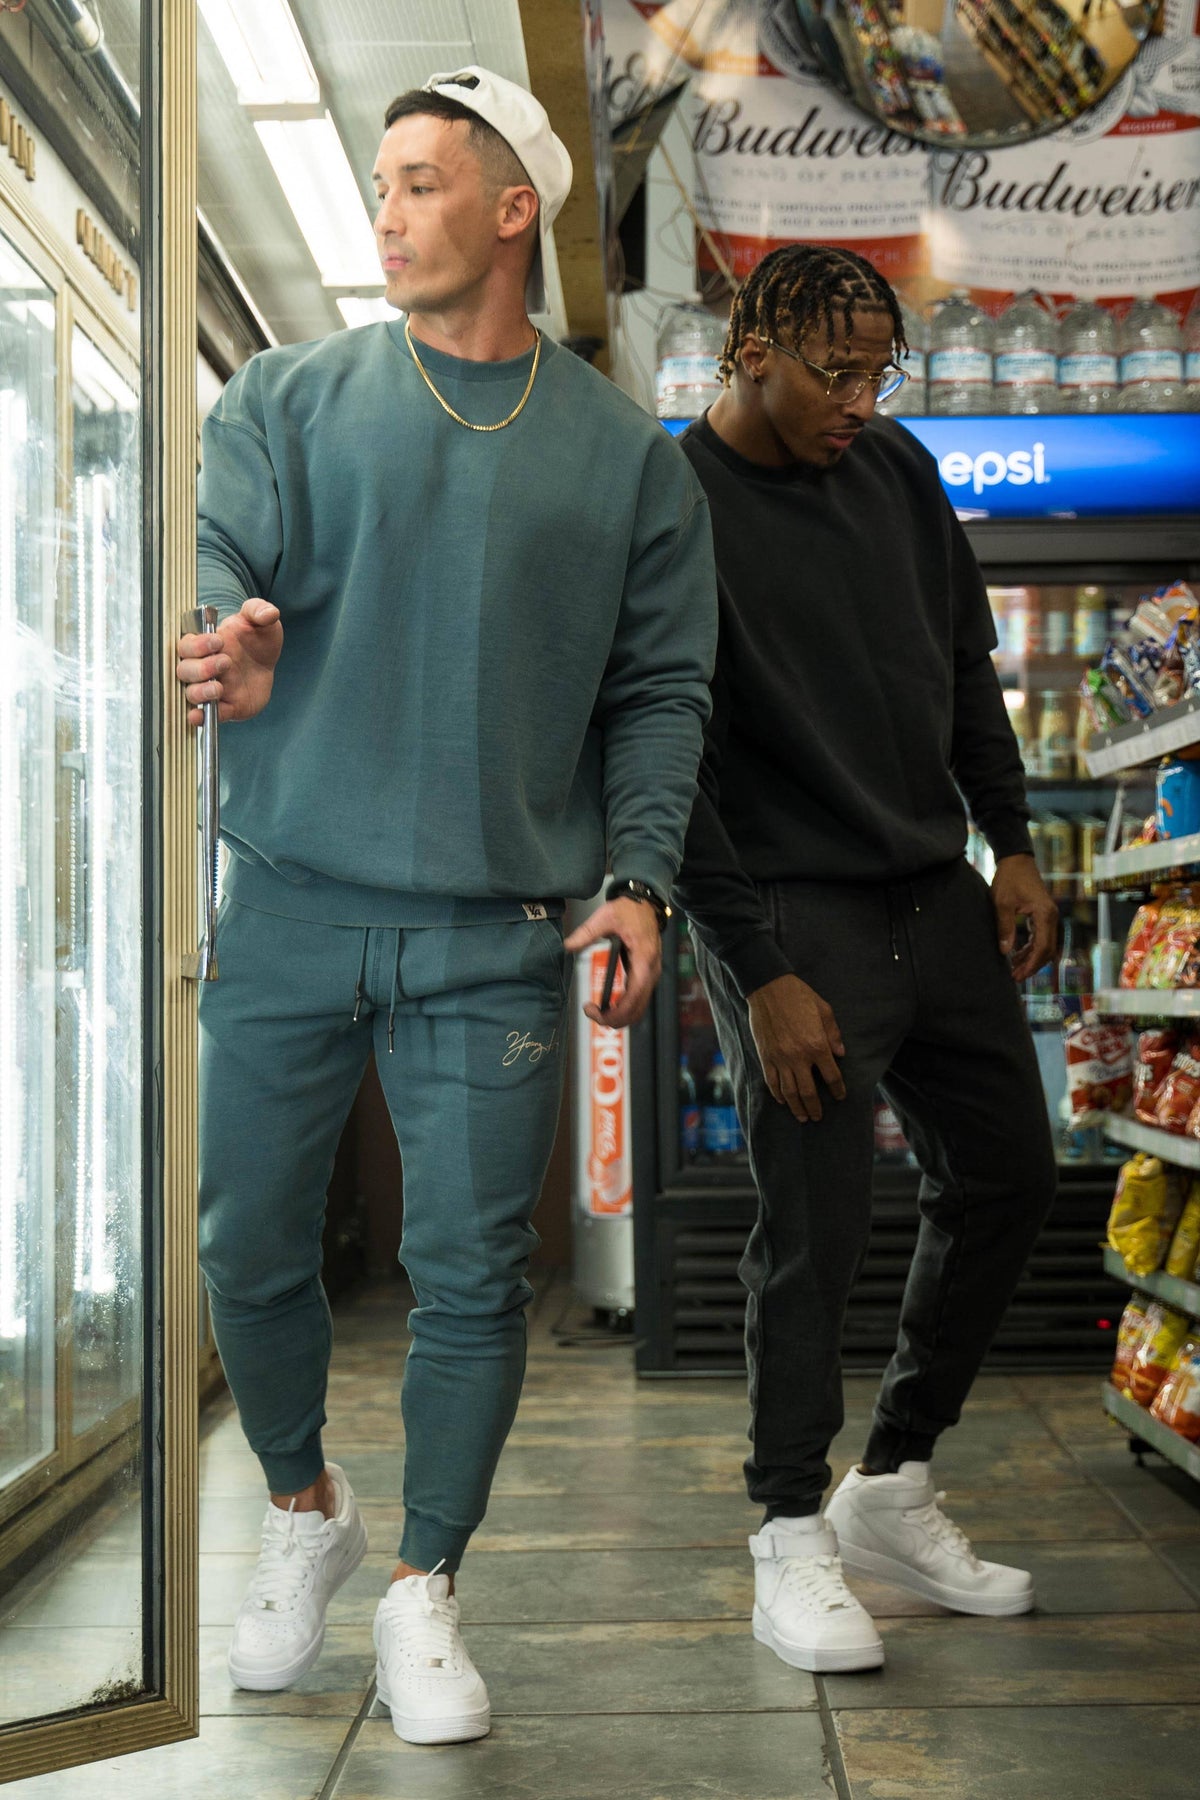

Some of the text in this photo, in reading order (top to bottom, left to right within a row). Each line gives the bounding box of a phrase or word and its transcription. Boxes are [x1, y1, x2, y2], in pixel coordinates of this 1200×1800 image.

[933, 149, 1200, 217] Budweiser
[938, 442, 1045, 495] epsi
[592, 1023, 623, 1107] Cok
